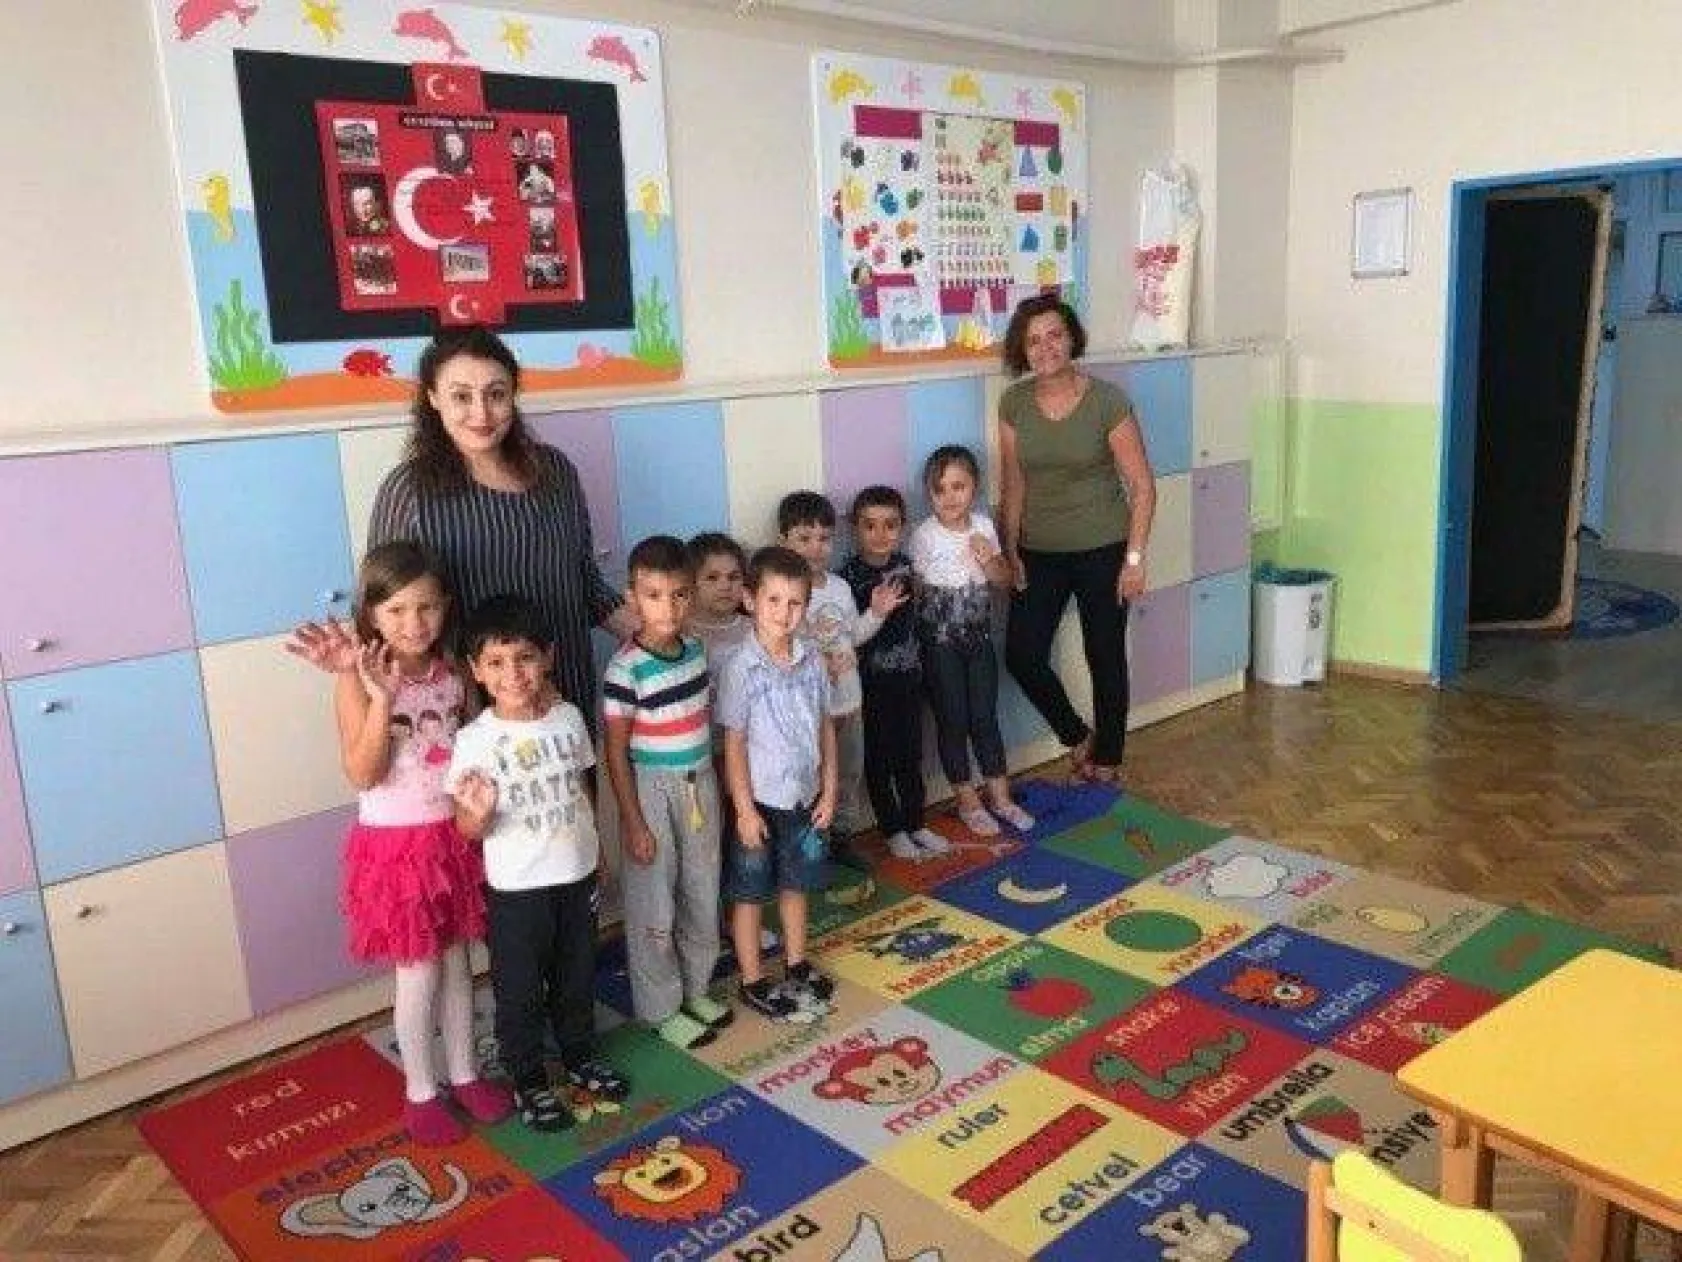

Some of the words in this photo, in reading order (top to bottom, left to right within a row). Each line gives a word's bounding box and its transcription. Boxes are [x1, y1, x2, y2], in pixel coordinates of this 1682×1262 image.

[232, 1078, 303, 1118] red
[1221, 1061, 1336, 1141] umbrella
[937, 1102, 1012, 1151] ruler
[1039, 1151, 1141, 1224] cetvel
[1126, 1152, 1208, 1209] bear
[731, 1213, 822, 1262] bird
